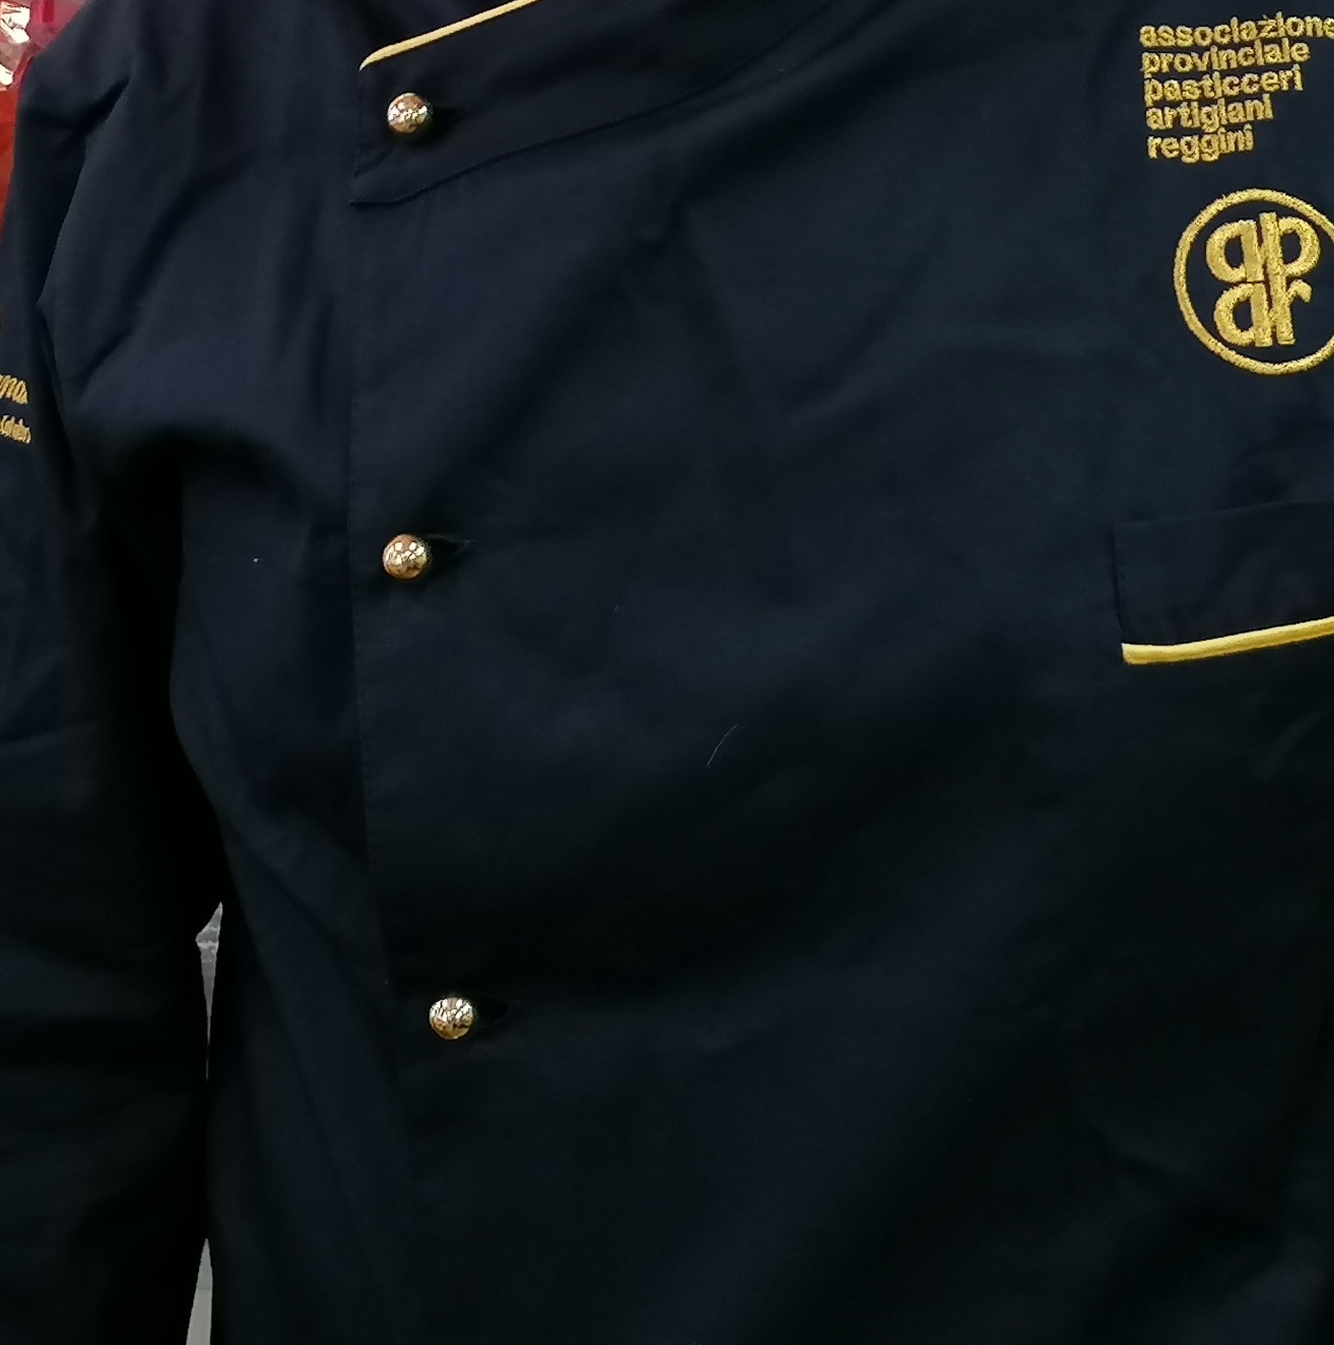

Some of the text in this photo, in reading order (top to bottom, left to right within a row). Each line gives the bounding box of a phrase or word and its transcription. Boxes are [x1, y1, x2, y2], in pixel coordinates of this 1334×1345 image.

[1140, 37, 1311, 75] provinciale
[1143, 64, 1304, 107] pasticceri
[1145, 93, 1274, 133] artigiani
[1147, 124, 1255, 164] reggini
